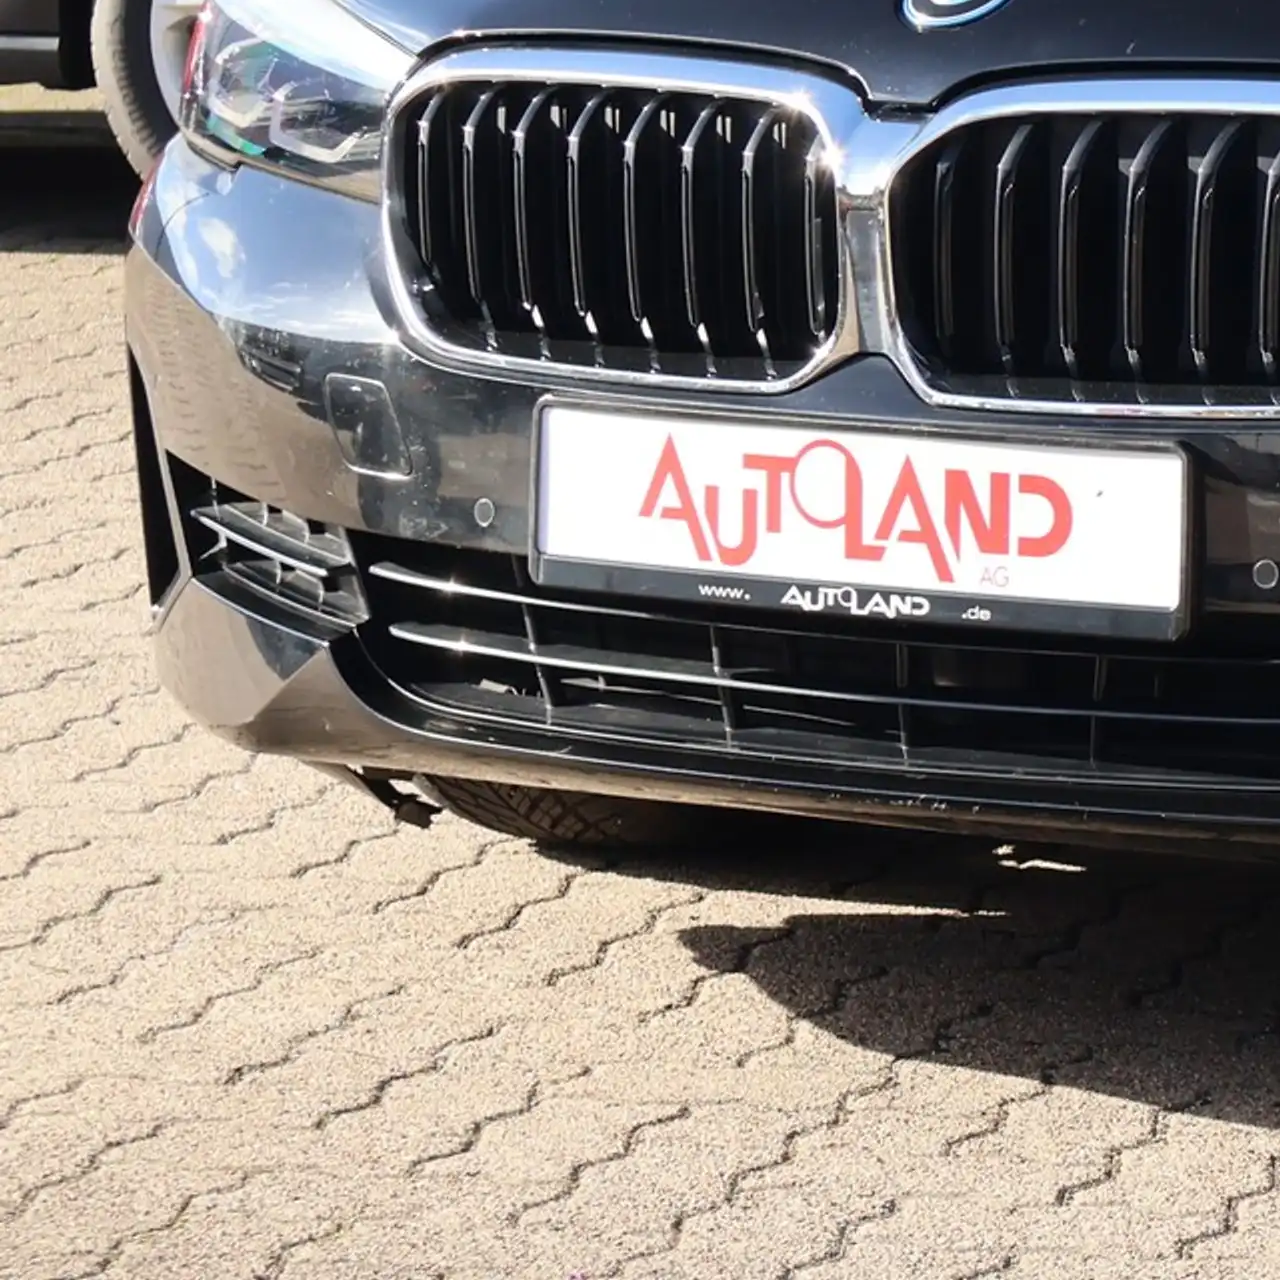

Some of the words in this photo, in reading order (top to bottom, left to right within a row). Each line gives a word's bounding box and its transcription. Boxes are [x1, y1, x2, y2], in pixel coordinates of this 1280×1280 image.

[640, 433, 1073, 583] AUTOLAND
[979, 566, 1009, 588] AG
[698, 584, 751, 601] www.
[780, 584, 930, 619] AUTOLAND
[961, 605, 992, 621] .de
